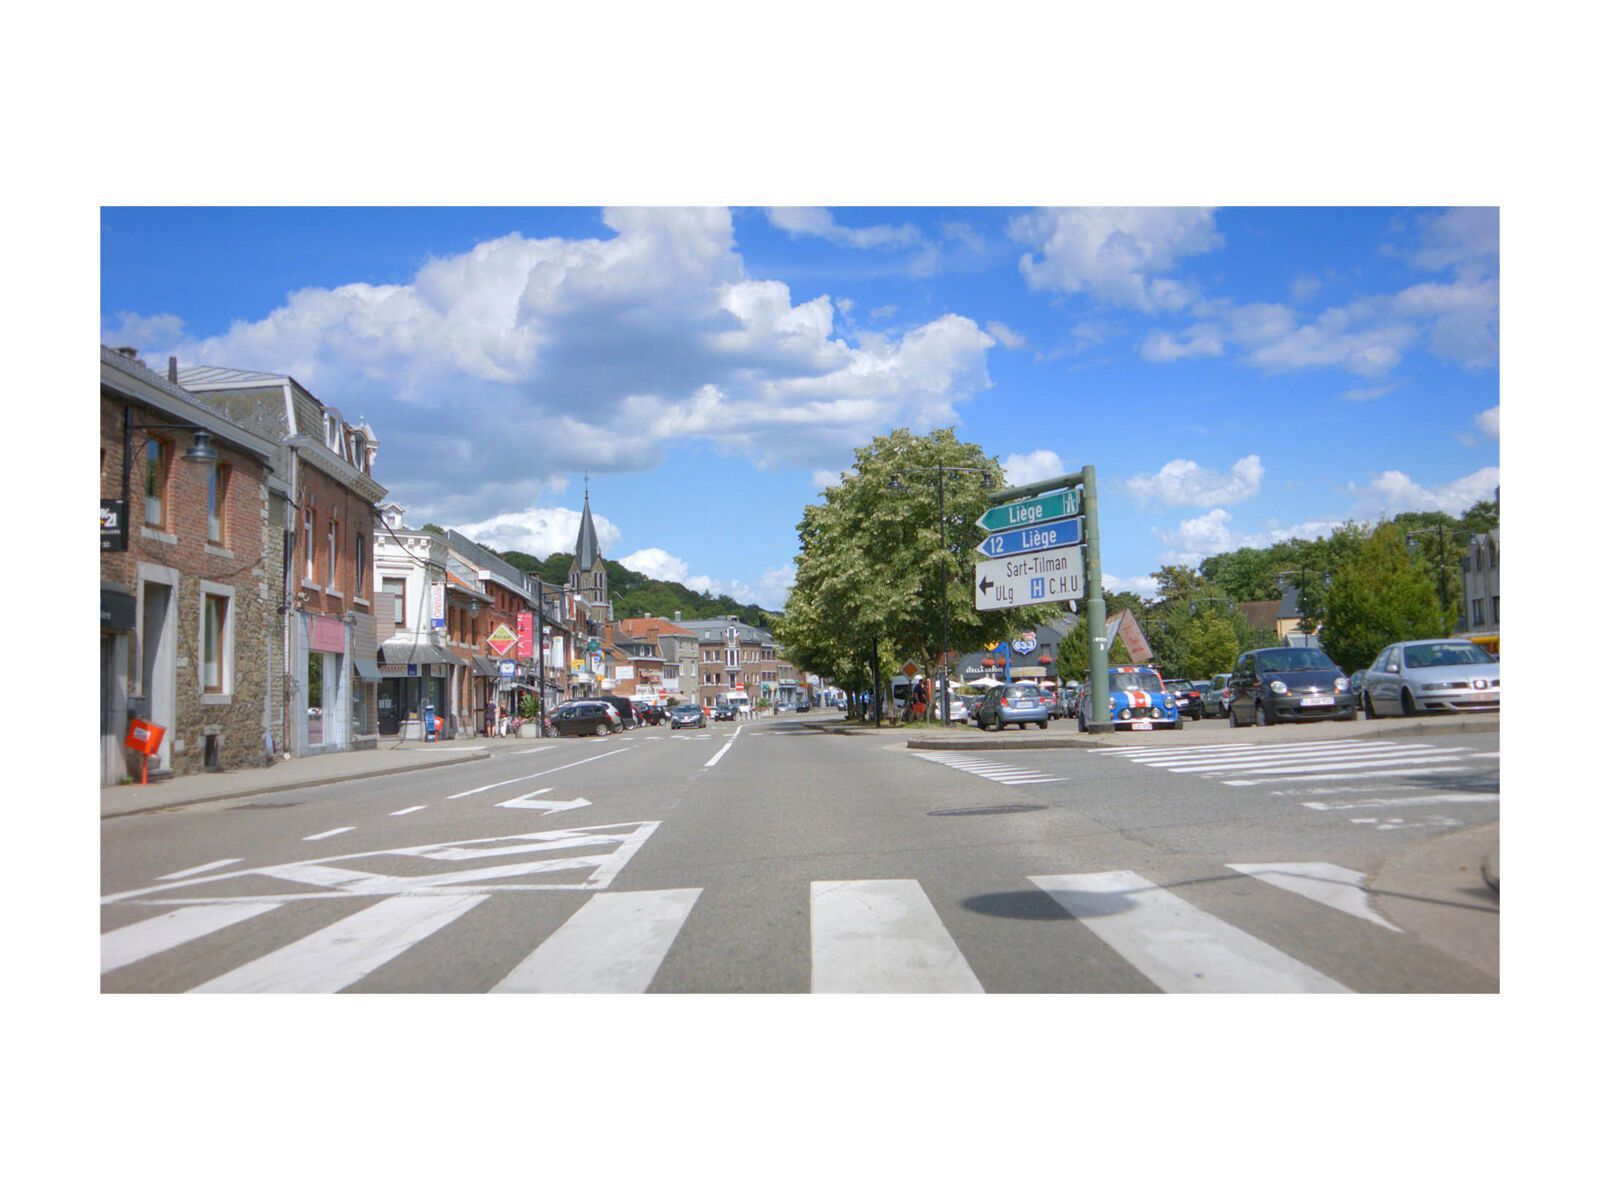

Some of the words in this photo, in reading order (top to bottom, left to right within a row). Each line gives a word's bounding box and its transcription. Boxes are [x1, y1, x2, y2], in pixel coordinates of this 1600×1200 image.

[1009, 505, 1043, 523] Liège
[989, 536, 1004, 554] 12
[1022, 530, 1057, 549] Liège
[1006, 557, 1068, 578] Sart-Tilman
[995, 584, 1014, 603] ULg
[1014, 641, 1034, 650] 633
